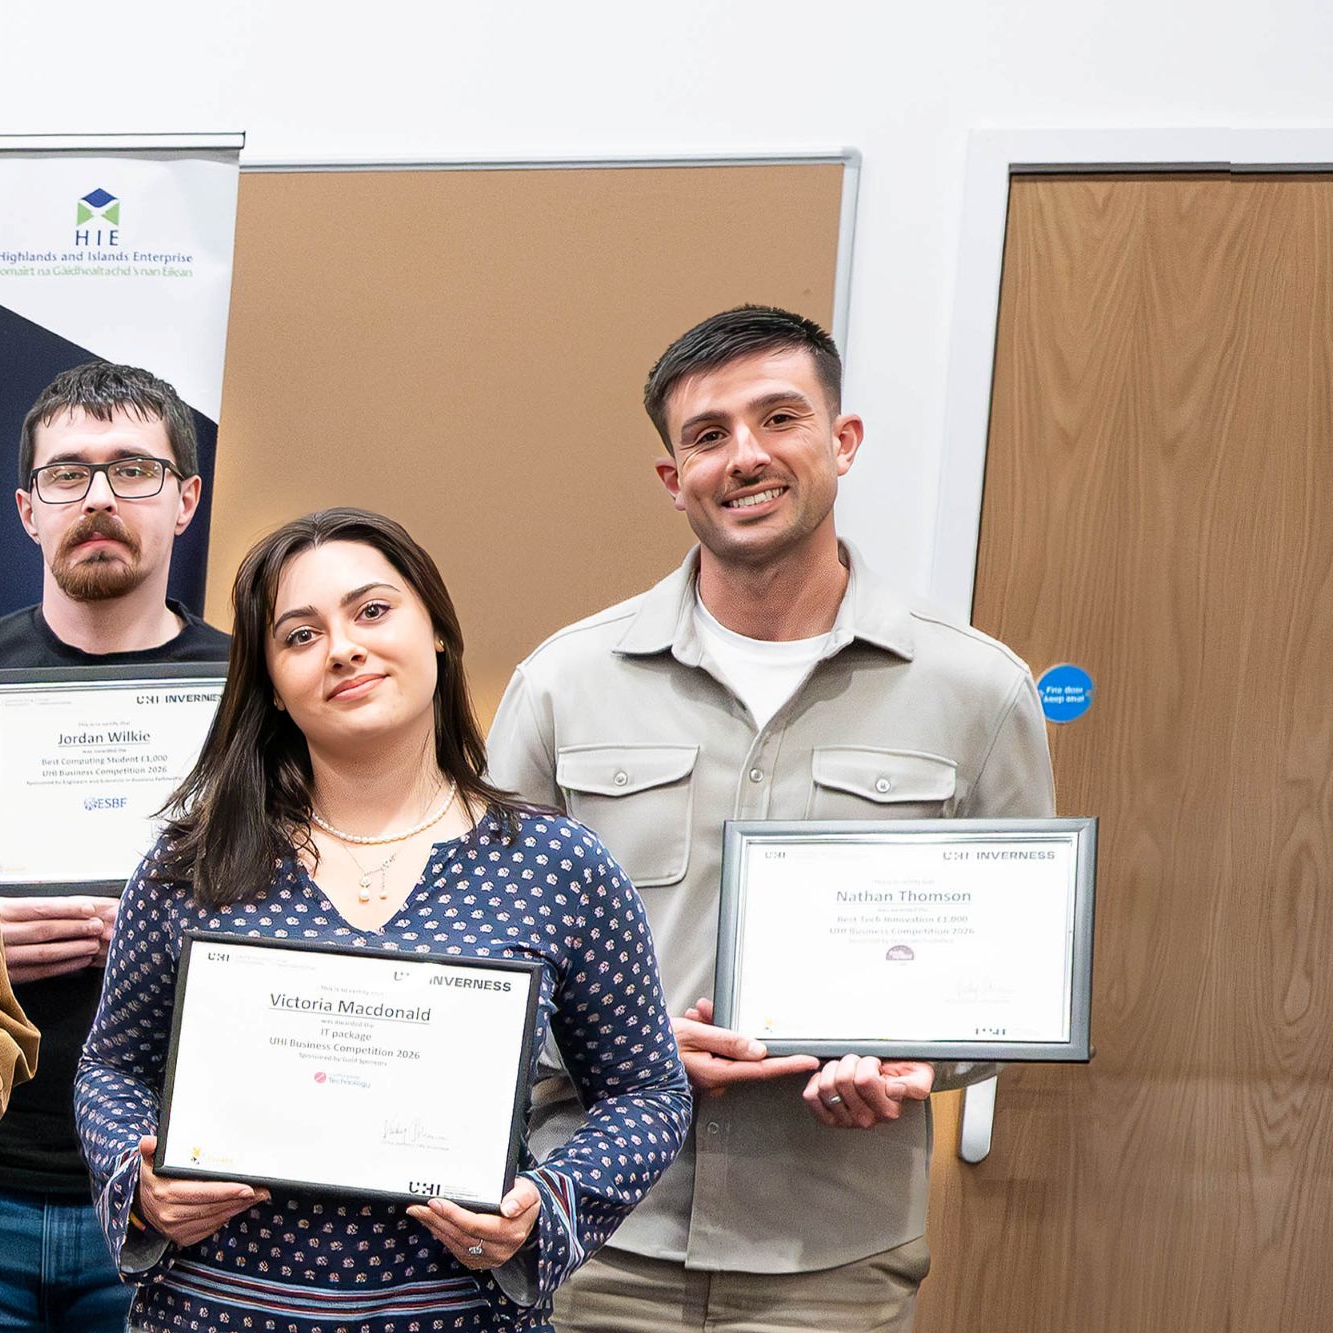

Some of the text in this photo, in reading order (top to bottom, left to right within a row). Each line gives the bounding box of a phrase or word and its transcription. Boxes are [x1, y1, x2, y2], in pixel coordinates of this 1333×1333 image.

[61, 252, 83, 261] and
[88, 252, 128, 261] Islands
[134, 253, 192, 264] Enterprise
[136, 694, 221, 705] UHI INVERNE
[58, 730, 151, 744] Jordan Wilkie
[98, 798, 127, 809] ESBF
[943, 851, 1055, 860] UHI INVERNESS
[837, 891, 971, 902] Nathan Thomson
[208, 953, 229, 963] UHI
[270, 993, 431, 1021] Victoria Macdonald
[332, 1029, 372, 1041] package
[270, 1037, 420, 1059] UHI Business Competition 2026
[409, 1181, 441, 1196] UHI
